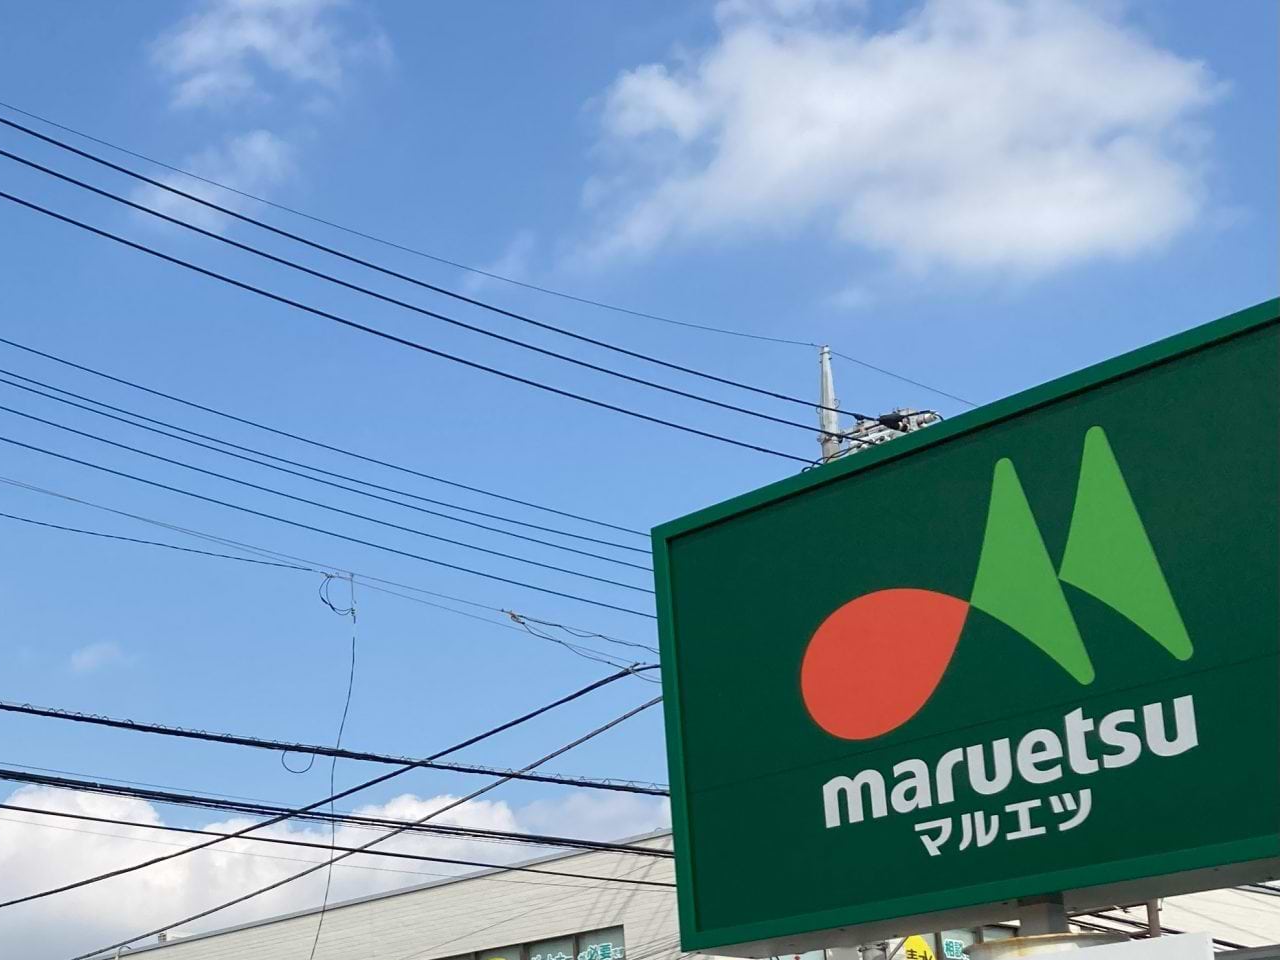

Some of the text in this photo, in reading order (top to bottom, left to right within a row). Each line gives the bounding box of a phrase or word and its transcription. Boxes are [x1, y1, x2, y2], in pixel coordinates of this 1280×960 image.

[822, 694, 1199, 829] maruetsu
[914, 788, 1093, 857] マルエツ
